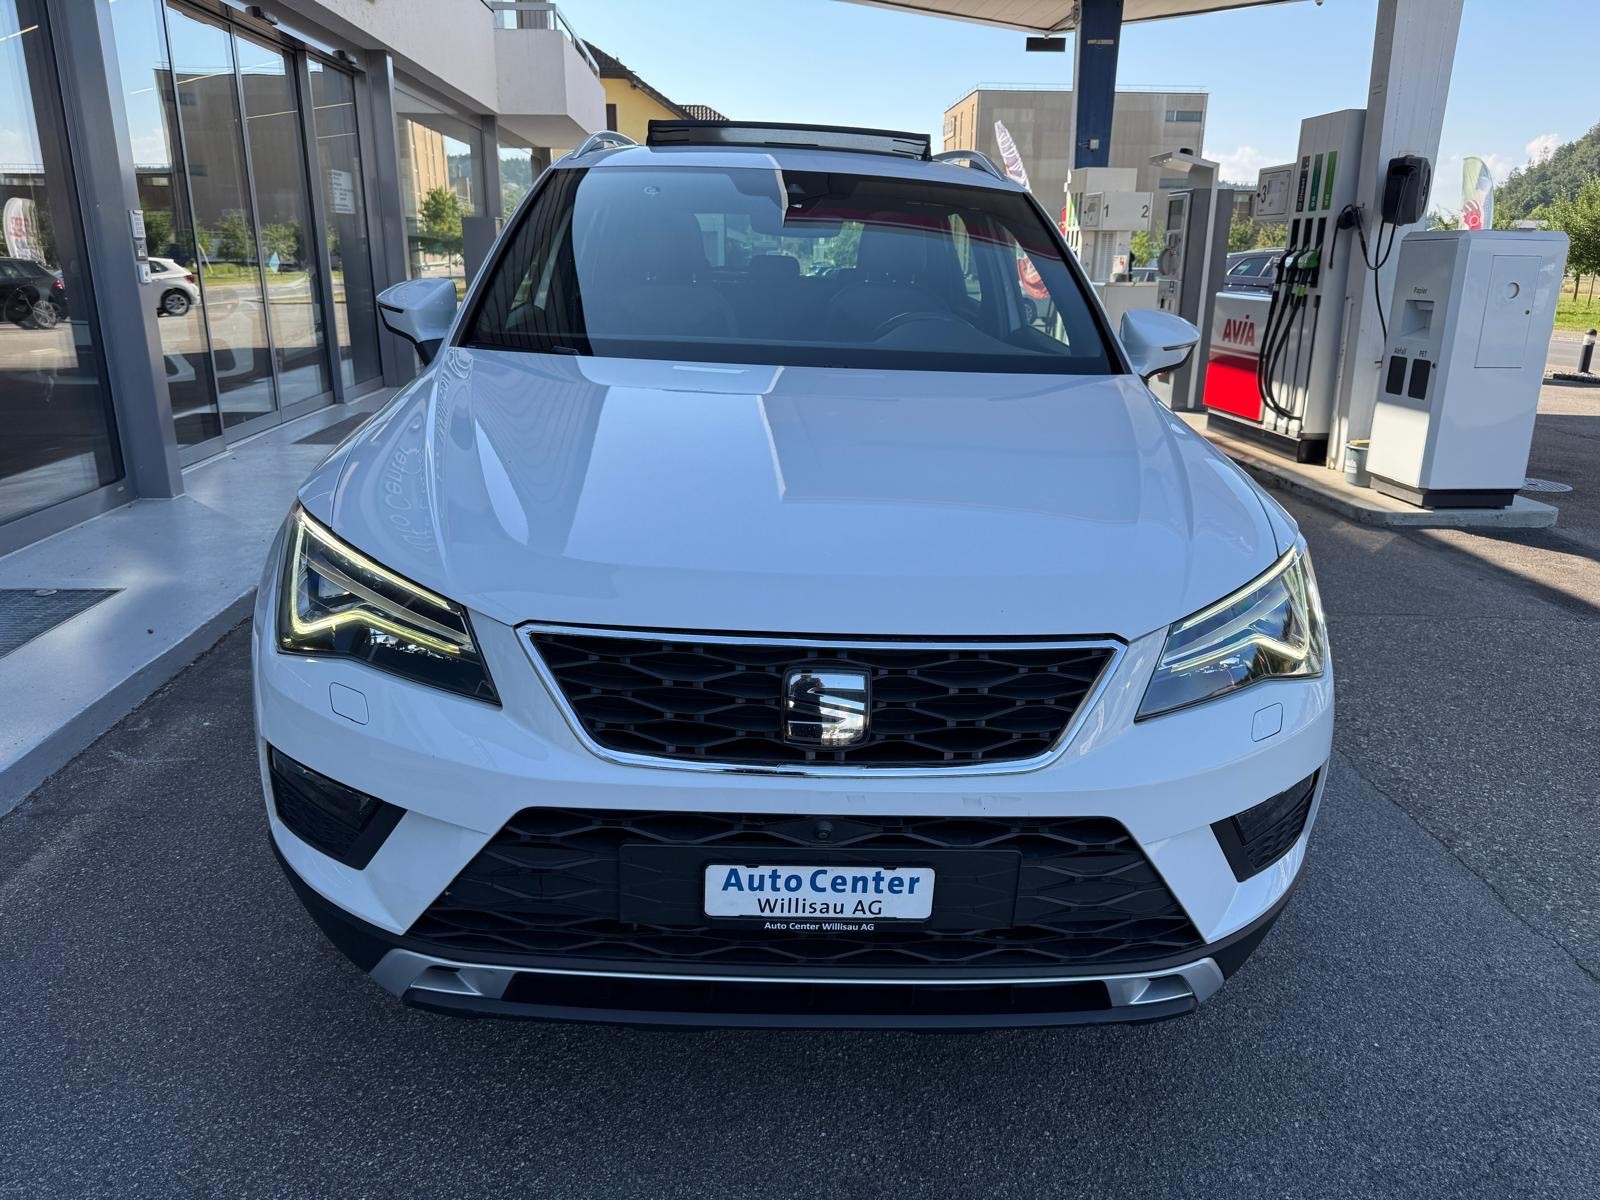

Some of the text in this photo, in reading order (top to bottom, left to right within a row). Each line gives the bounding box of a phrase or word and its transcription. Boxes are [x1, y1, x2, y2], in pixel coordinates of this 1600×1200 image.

[1261, 185, 1267, 203] 3
[1103, 204, 1110, 217] 1
[1141, 204, 1149, 218] 2
[1419, 350, 1428, 358] PET
[721, 868, 921, 894] Auto Center
[758, 898, 883, 915] Willisau AG
[764, 922, 787, 930] Auto
[789, 922, 820, 931] Center
[822, 923, 859, 931] Willisau
